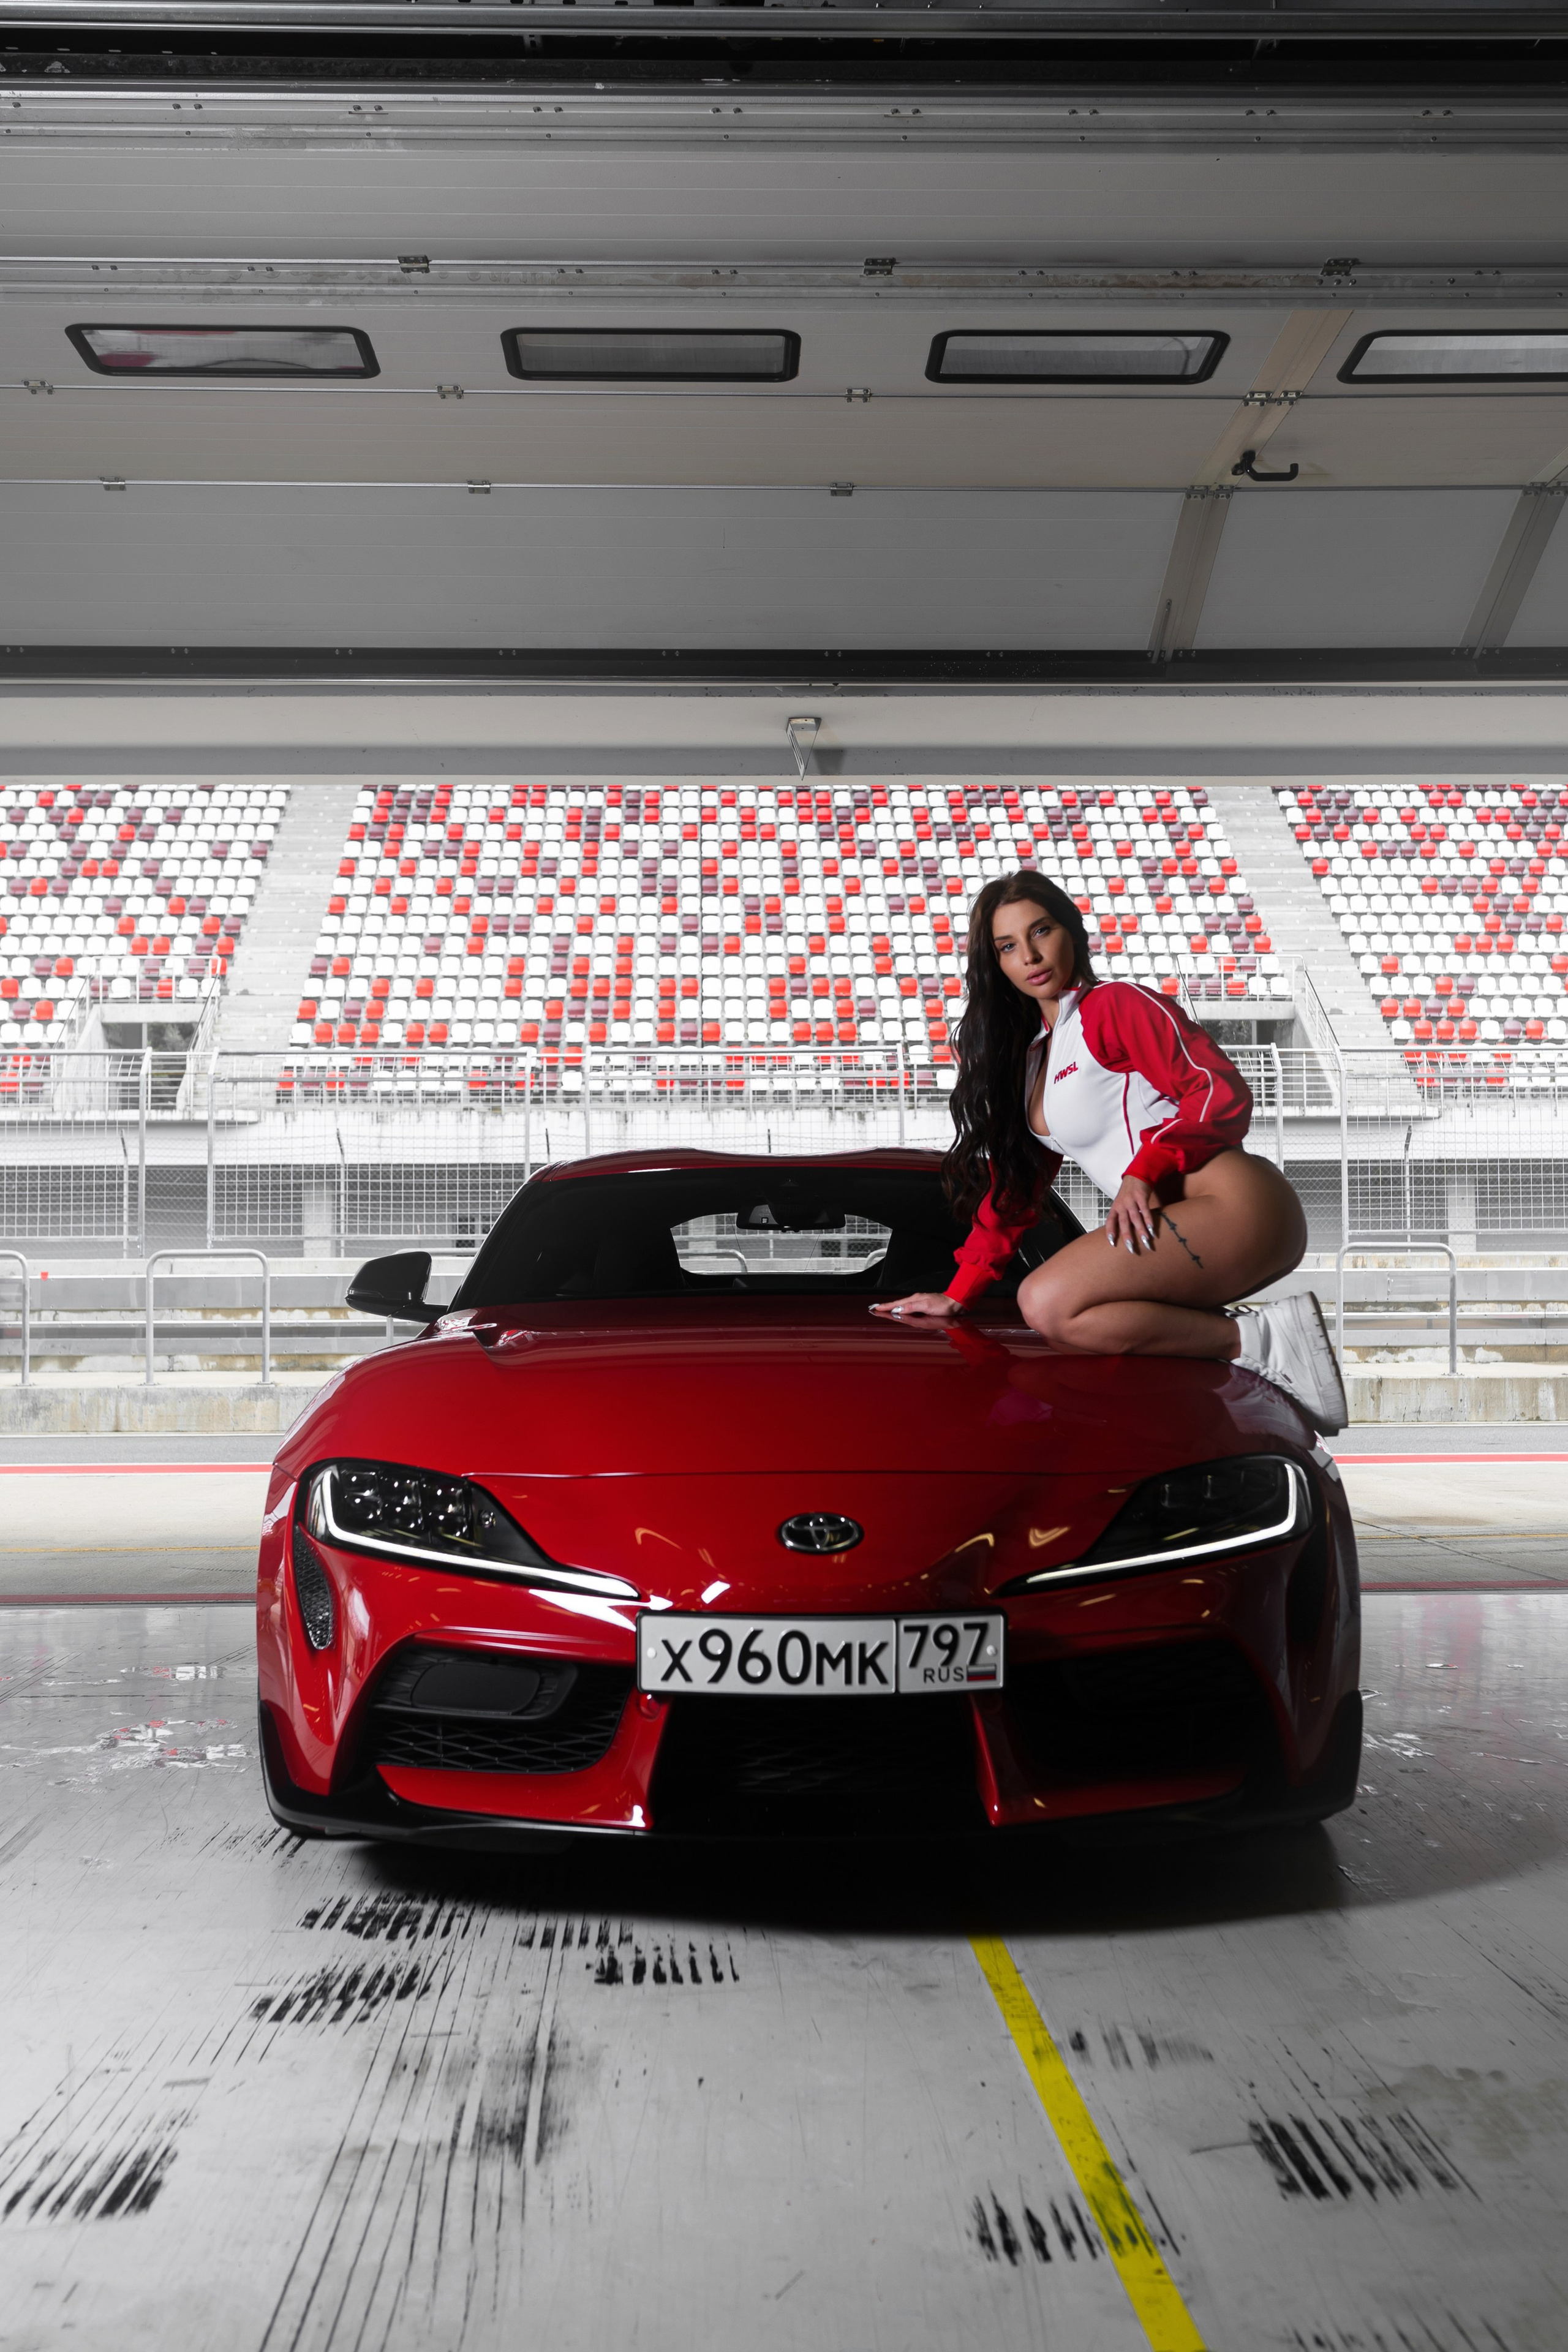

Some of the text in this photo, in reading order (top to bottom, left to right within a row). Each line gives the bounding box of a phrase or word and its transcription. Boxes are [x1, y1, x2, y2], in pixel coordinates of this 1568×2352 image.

[1054, 1061, 1079, 1084] HWSL
[903, 1621, 990, 1668] 797
[923, 1665, 965, 1684] RUS
